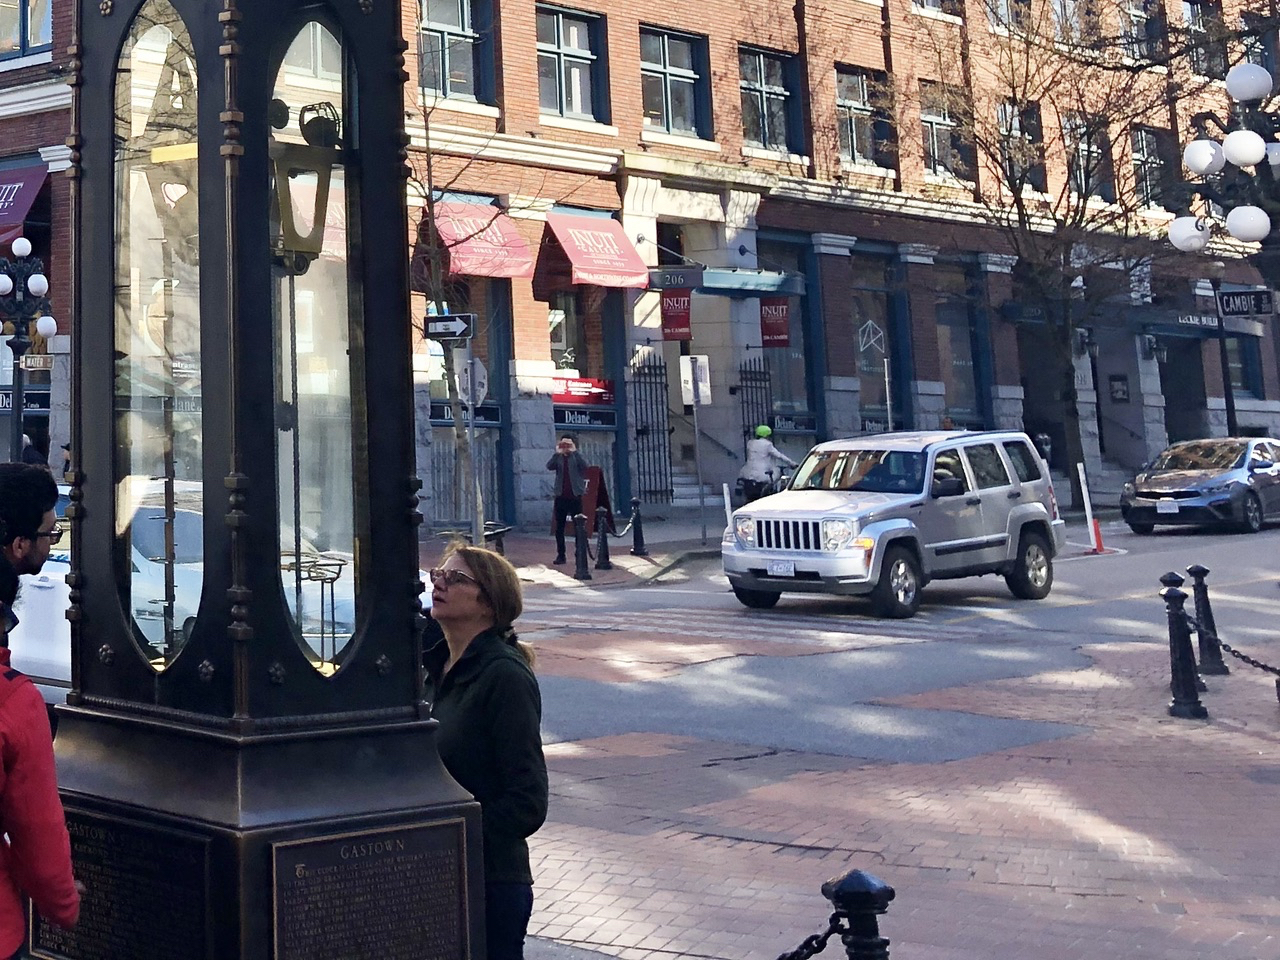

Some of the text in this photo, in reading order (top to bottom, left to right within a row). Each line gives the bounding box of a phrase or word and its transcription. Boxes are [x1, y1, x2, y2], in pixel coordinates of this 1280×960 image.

[448, 217, 503, 238] INUIT
[568, 228, 621, 249] INUIT
[665, 274, 684, 285] 206
[663, 297, 689, 308] INUIT
[1223, 295, 1257, 312] CAMBIE
[762, 305, 788, 316] INUIT
[26, 357, 43, 368] WATER
[565, 410, 591, 425] Delané
[340, 839, 404, 859] GASTOWN
